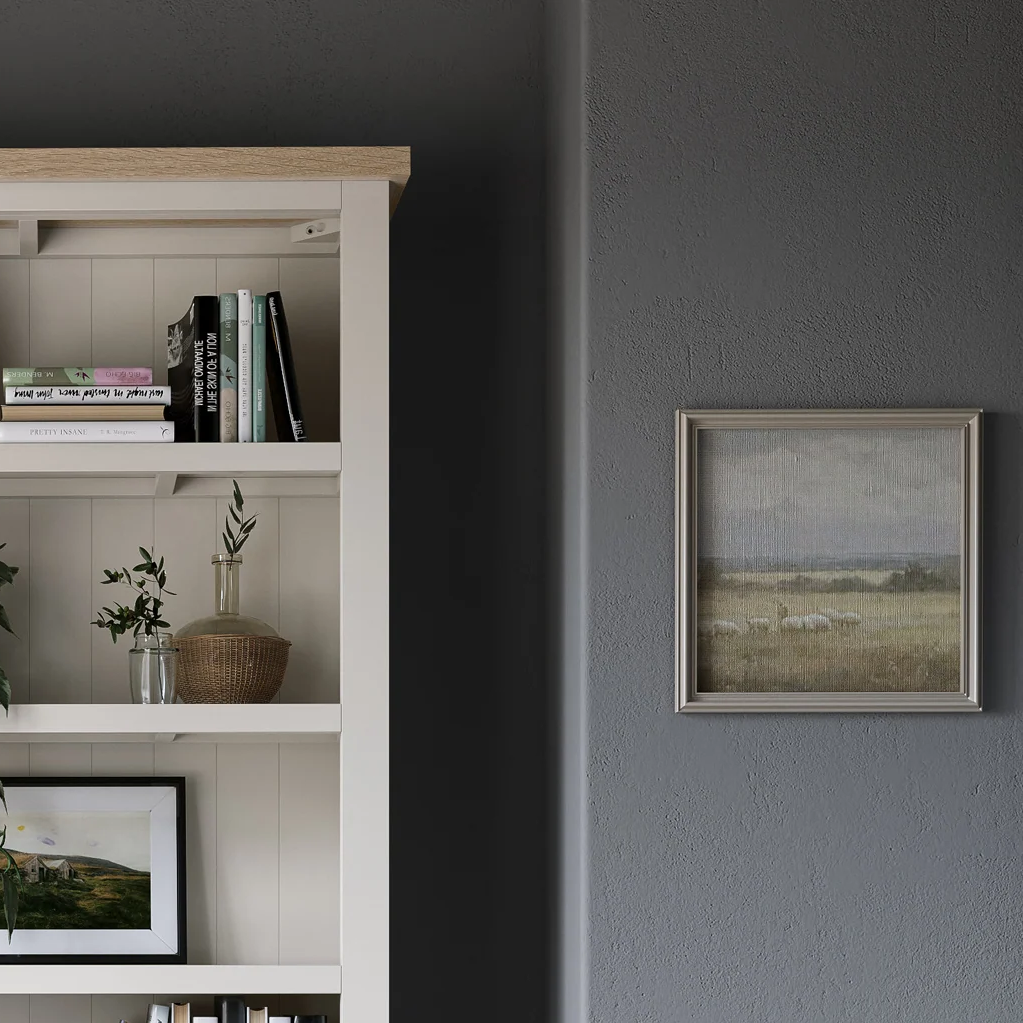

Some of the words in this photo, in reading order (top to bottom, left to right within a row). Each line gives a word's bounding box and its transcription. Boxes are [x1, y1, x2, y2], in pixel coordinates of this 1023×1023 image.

[35, 388, 54, 399] John
[29, 428, 59, 436] PRETTY
[60, 428, 87, 436] INSANE
